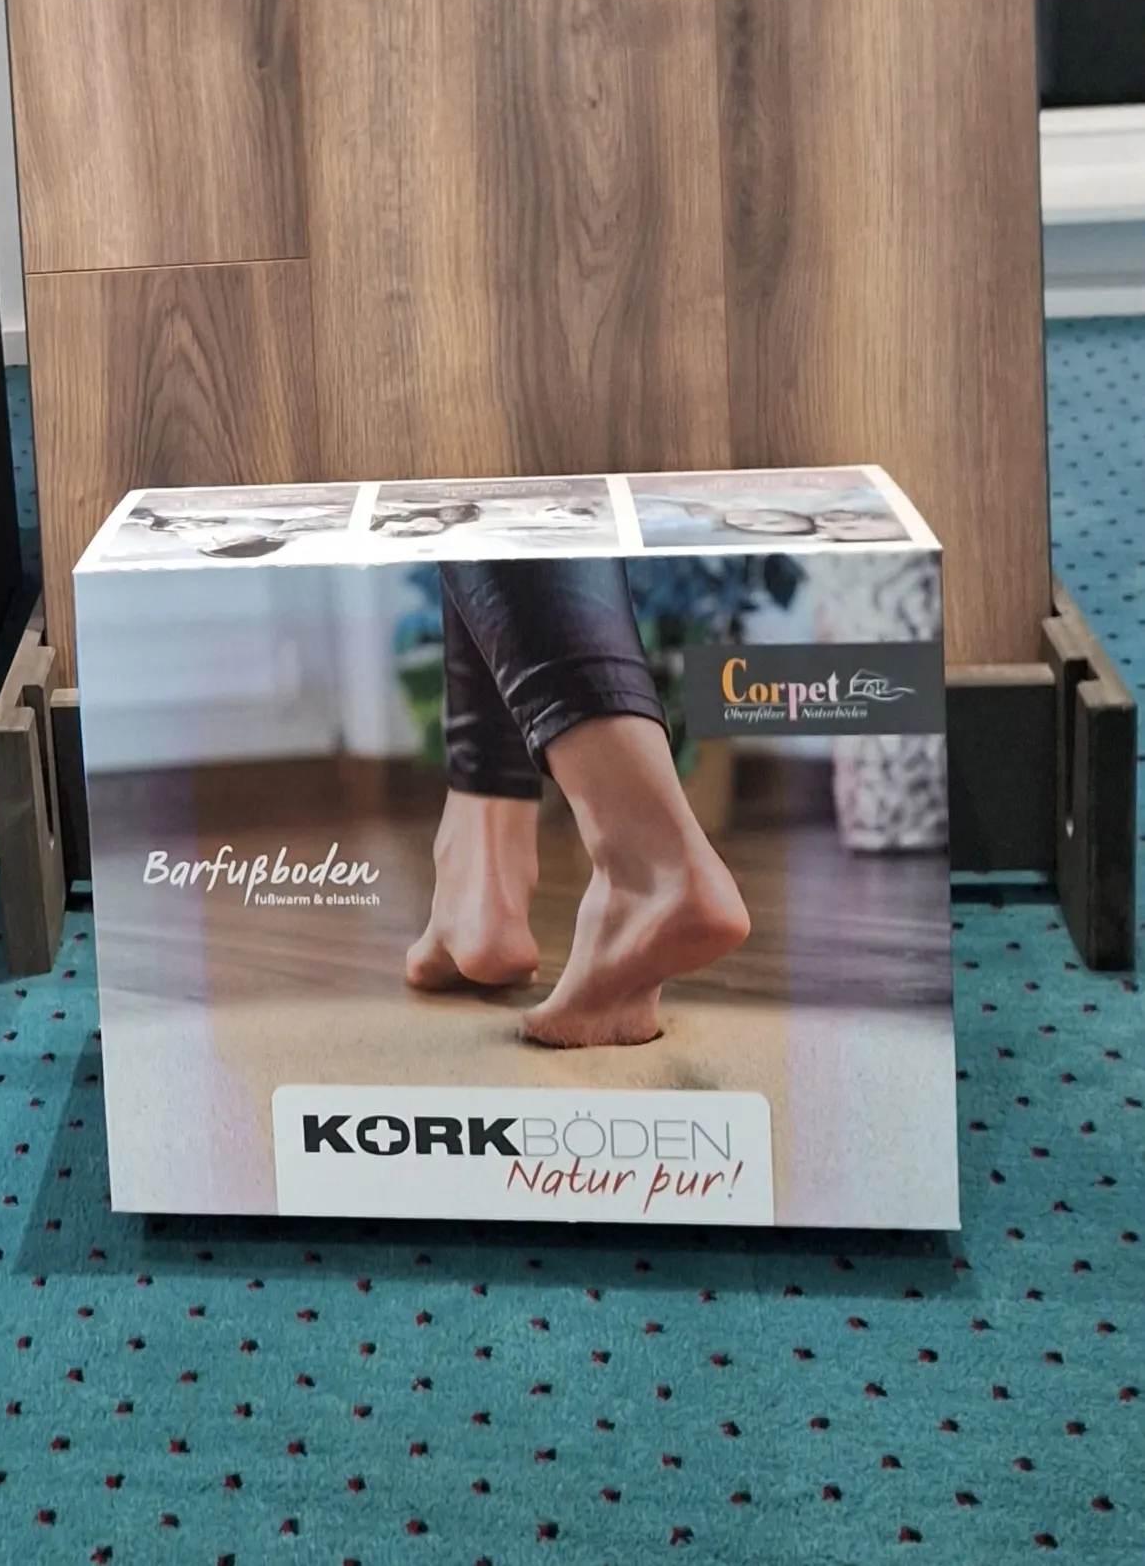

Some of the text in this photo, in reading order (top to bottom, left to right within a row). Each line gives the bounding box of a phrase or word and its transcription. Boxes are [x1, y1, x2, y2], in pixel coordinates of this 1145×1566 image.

[721, 657, 840, 721] Corpet
[142, 841, 380, 907] Barfußboden
[254, 893, 380, 906] fußwarm & elastisch
[506, 1156, 744, 1214] Natur pur!
